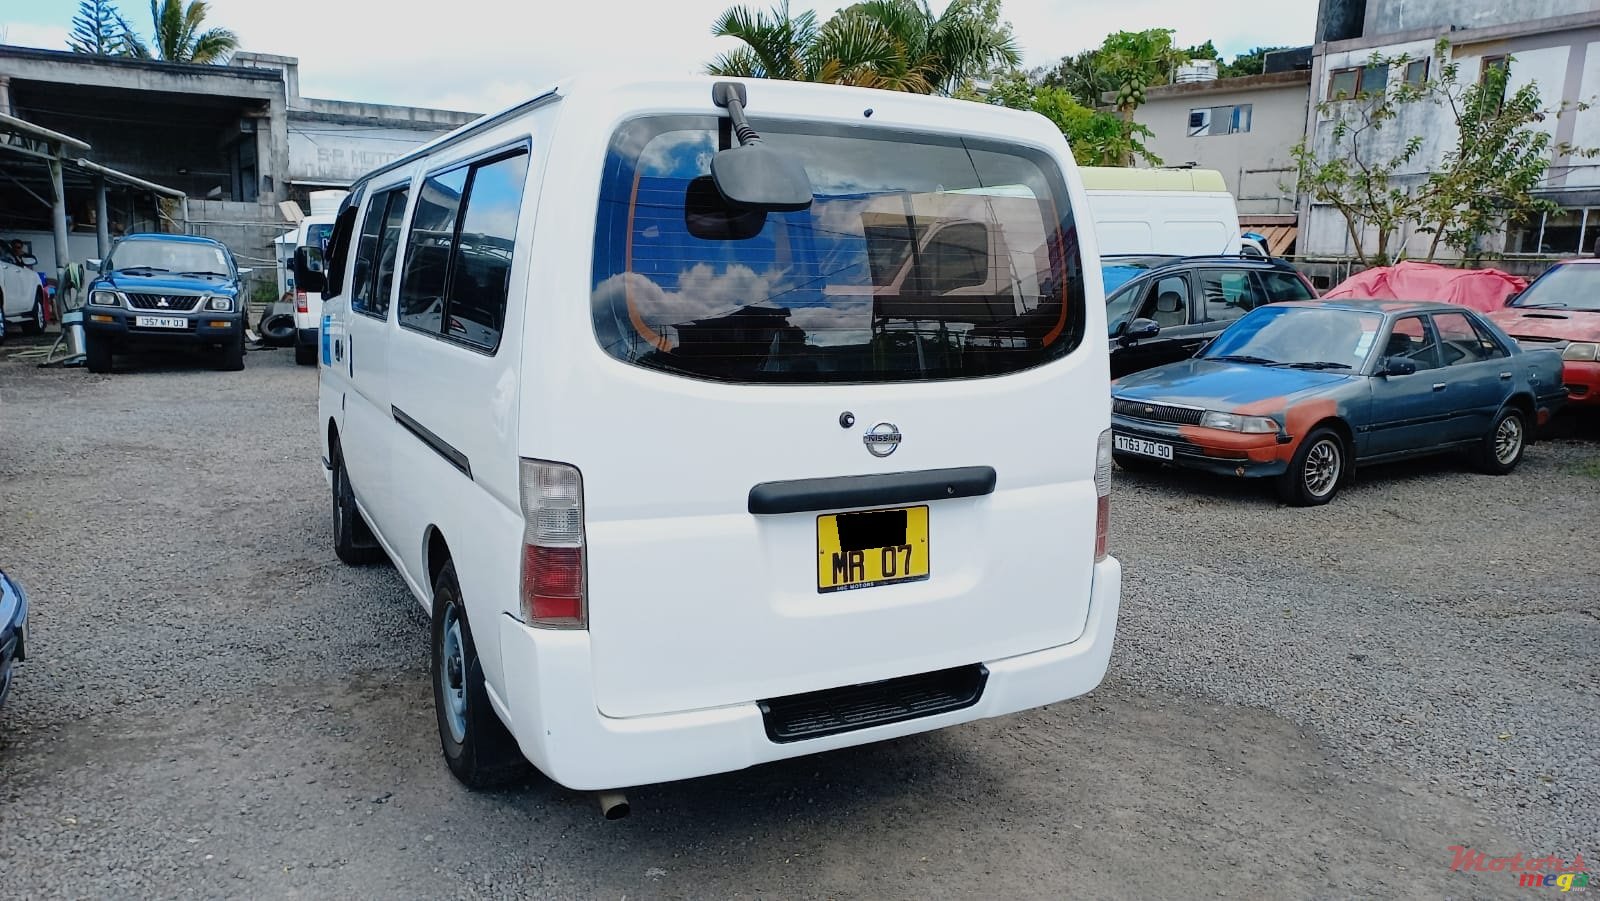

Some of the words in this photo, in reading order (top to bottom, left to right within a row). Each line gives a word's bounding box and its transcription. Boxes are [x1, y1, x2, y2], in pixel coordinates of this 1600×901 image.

[141, 317, 159, 326] 1357
[160, 319, 171, 327] MY
[173, 319, 184, 327] 03
[868, 434, 898, 442] NISSAN
[1118, 437, 1140, 451] 1763
[1157, 444, 1170, 457] 90
[831, 550, 865, 584] MR
[881, 543, 912, 578] 07
